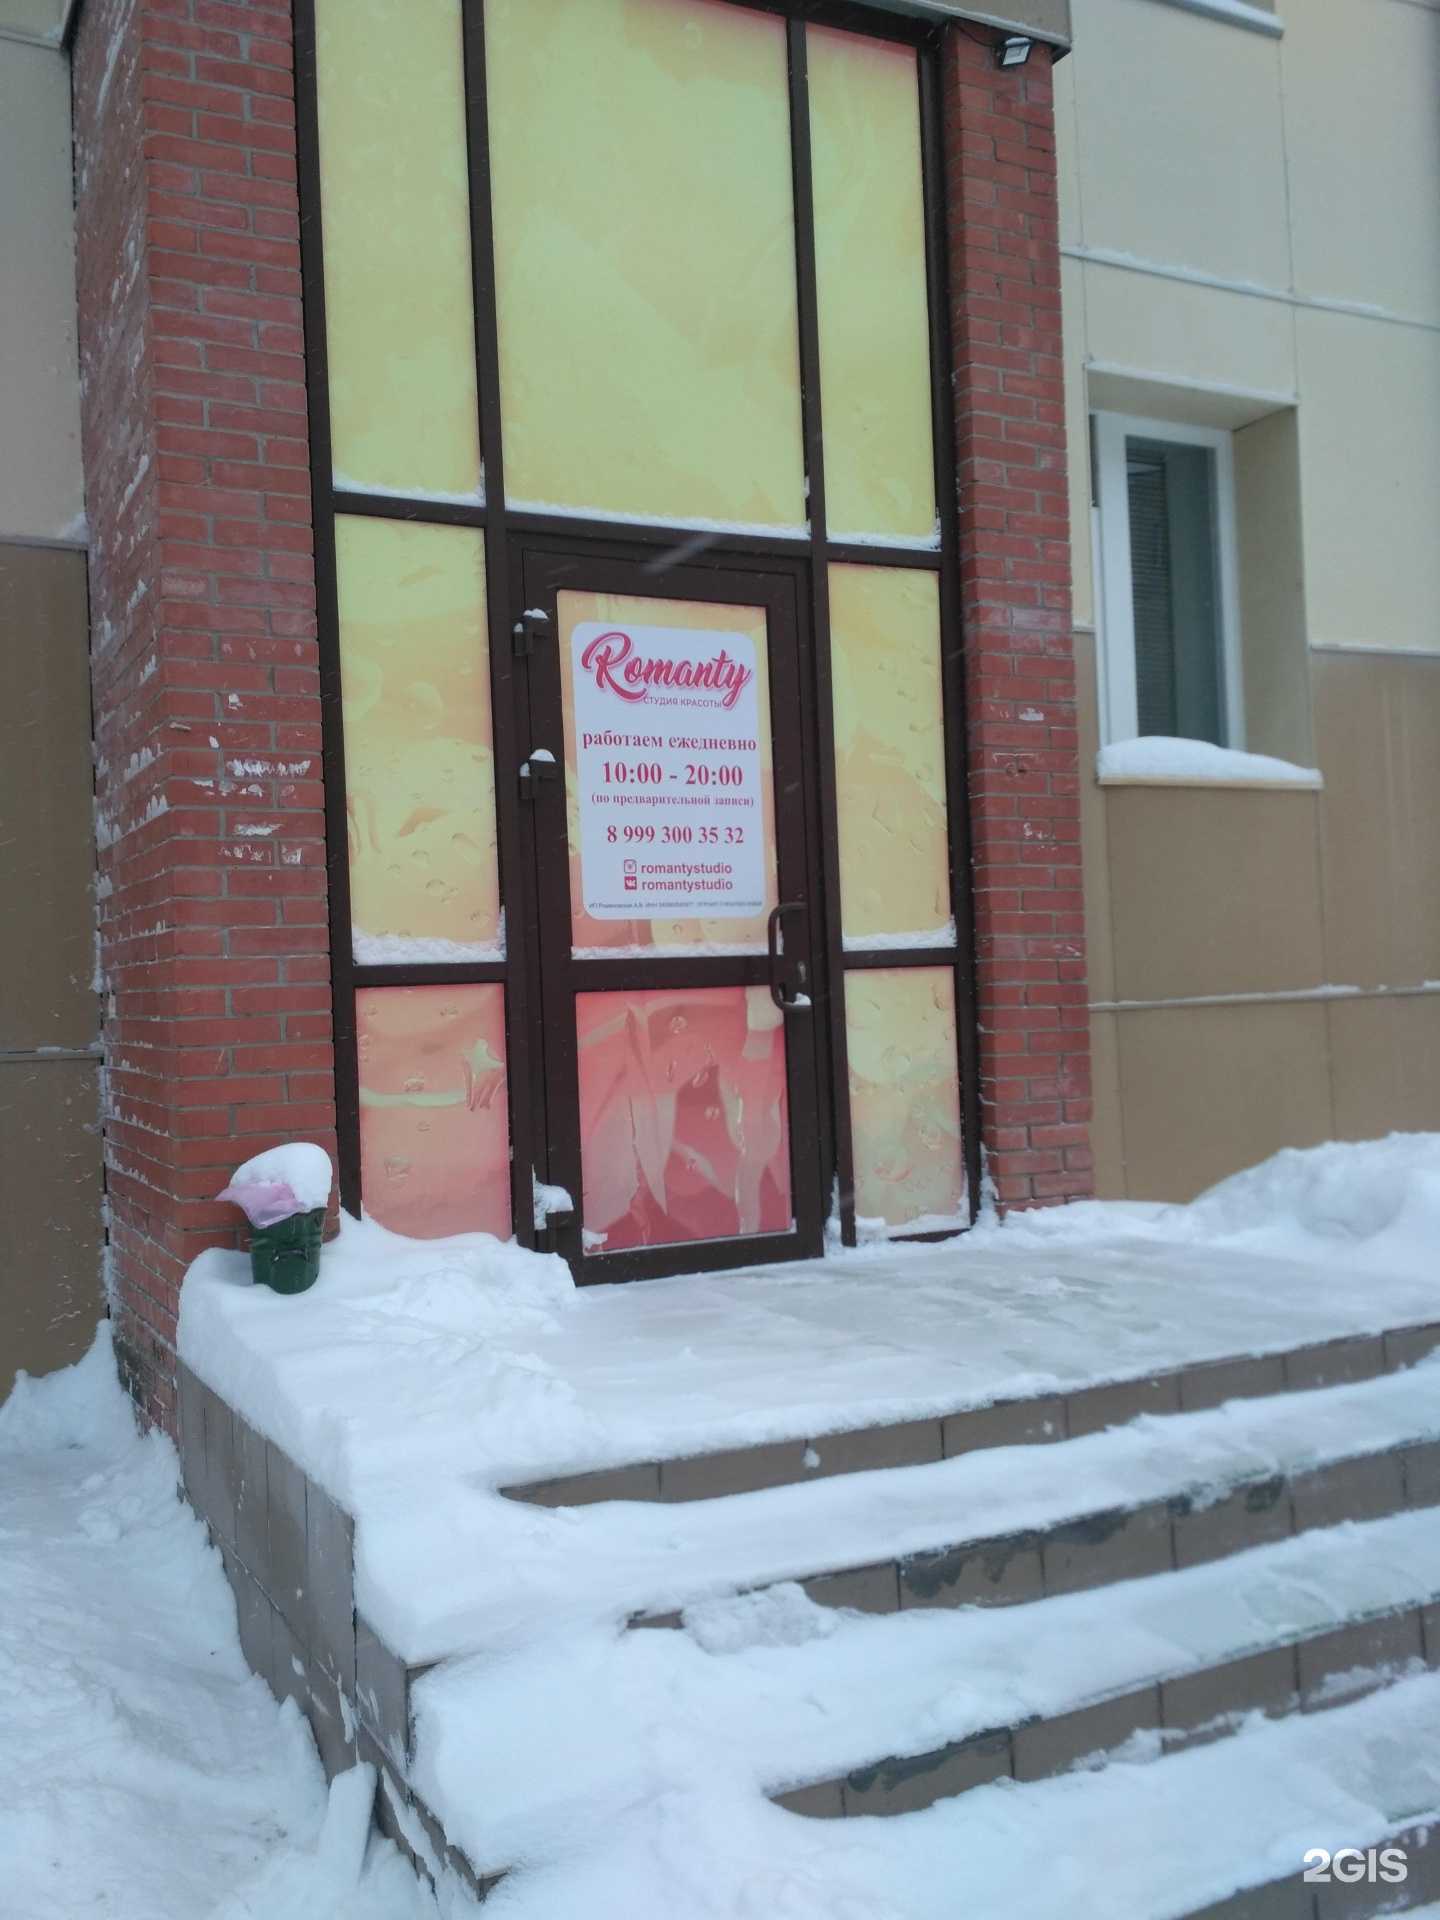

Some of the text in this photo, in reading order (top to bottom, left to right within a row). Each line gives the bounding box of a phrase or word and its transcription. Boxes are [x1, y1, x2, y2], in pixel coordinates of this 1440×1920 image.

[581, 632, 752, 709] Romanty
[643, 696, 722, 708] СТУДИЯ КРАСОТЫ
[583, 730, 757, 751] работаем ежедневно
[603, 761, 662, 784] 10:00
[684, 764, 743, 786] 20:00
[591, 792, 754, 807] (по предварительной записи)
[607, 825, 744, 844] 8 999 300 35 32
[641, 862, 733, 877] romantystudio
[642, 878, 734, 893] romantystudio
